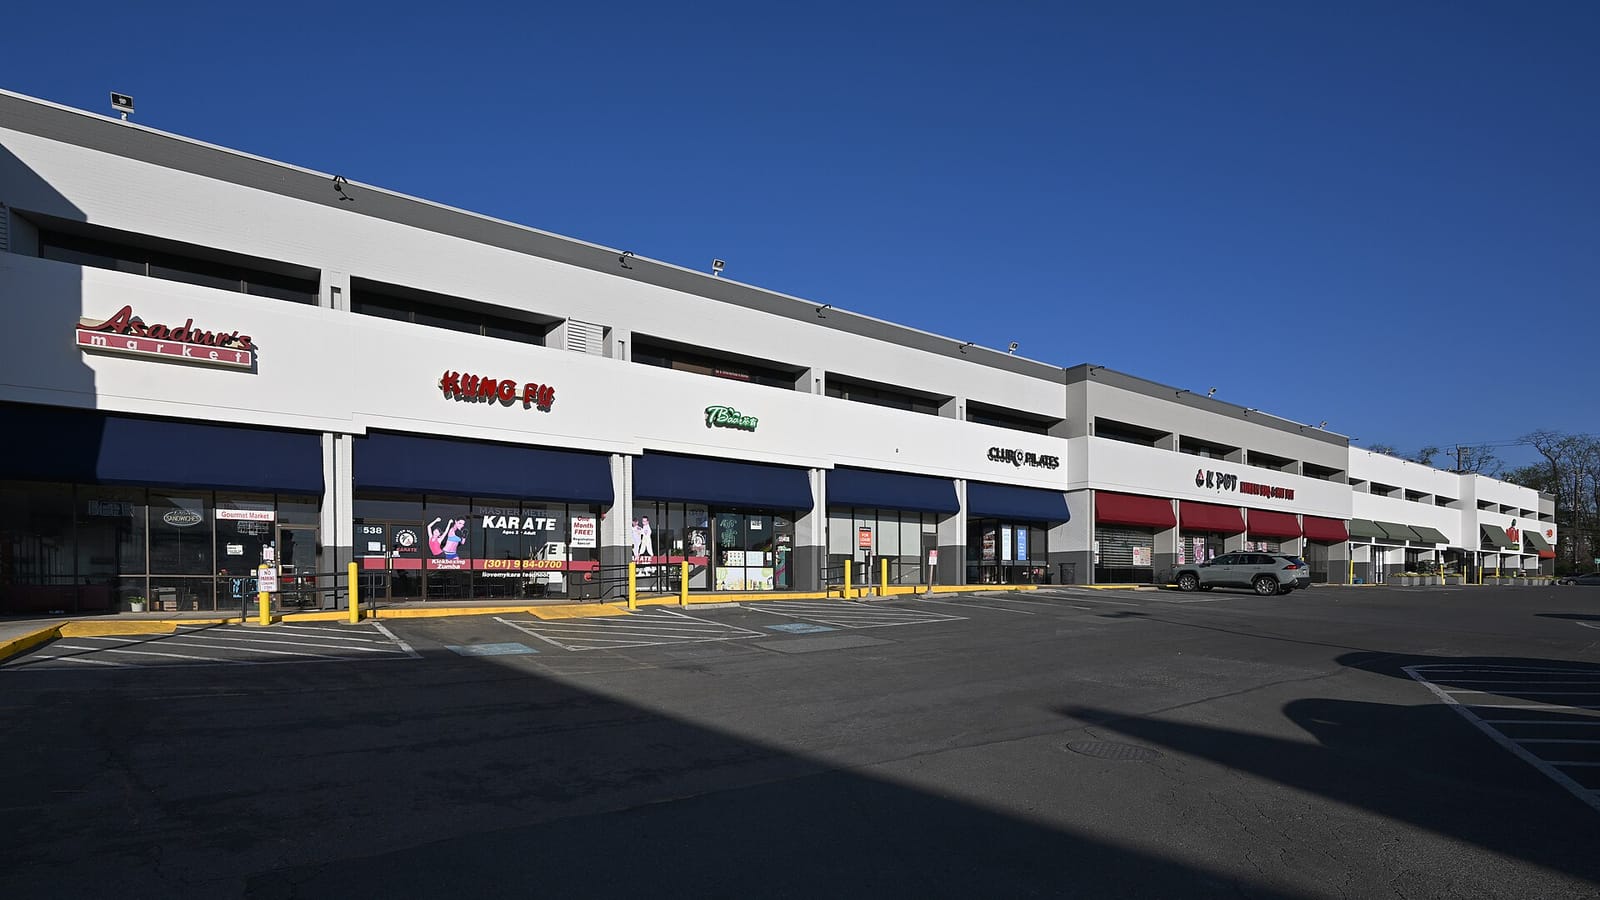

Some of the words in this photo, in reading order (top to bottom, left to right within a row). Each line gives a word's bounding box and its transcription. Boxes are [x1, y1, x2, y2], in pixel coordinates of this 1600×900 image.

[76, 305, 252, 350] Asadur's
[91, 335, 242, 363] market
[439, 370, 517, 401] KUNG
[523, 383, 555, 408] FU
[988, 447, 1014, 461] CLUB
[1025, 452, 1059, 467] PILATES
[221, 511, 248, 519] Gourmet
[482, 515, 557, 531] KARATE
[363, 526, 382, 534] 538
[483, 559, 511, 570] (301)
[513, 559, 562, 569] 984-0700
